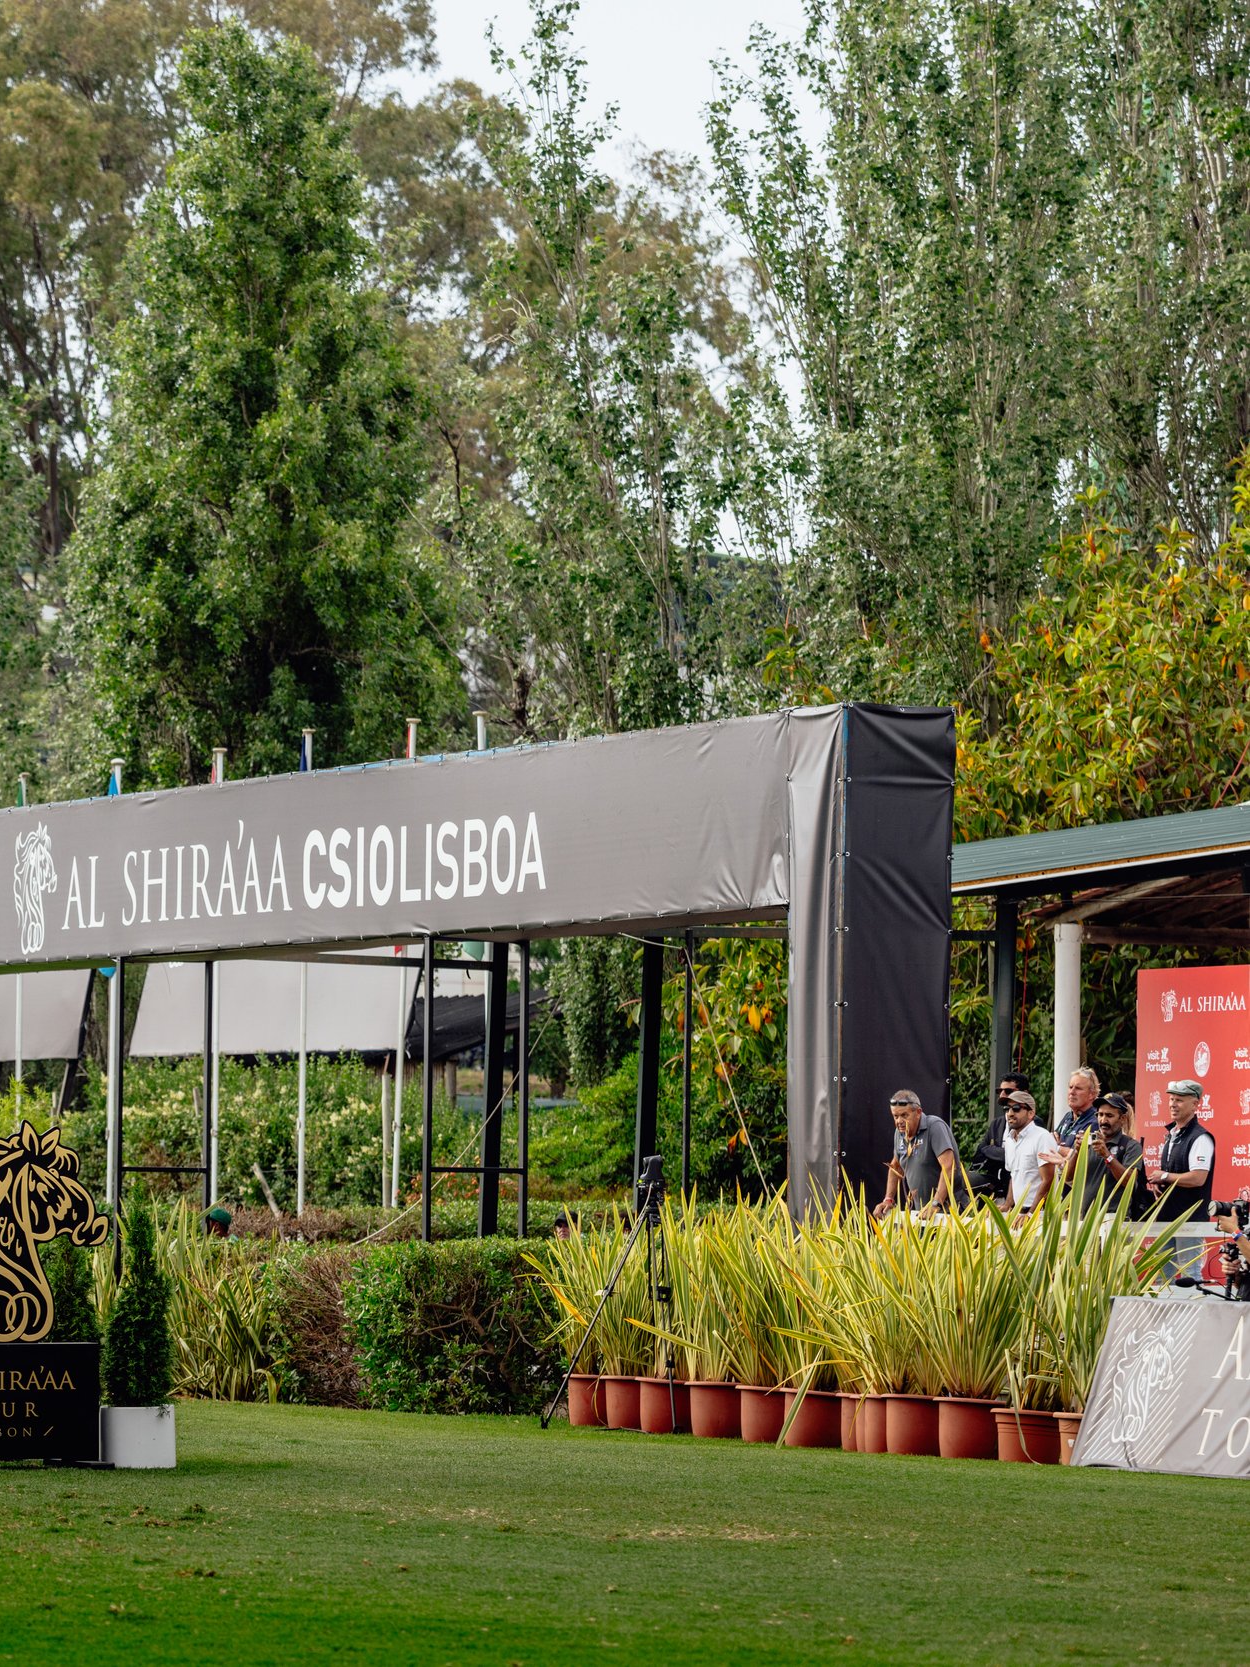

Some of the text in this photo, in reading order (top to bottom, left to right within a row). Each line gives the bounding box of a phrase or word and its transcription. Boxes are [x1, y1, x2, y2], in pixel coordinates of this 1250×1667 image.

[61, 811, 547, 930] AL SHIRA'AA CSIOLISBOA
[1179, 991, 1247, 1013] AL SHIRA'AA
[1147, 1050, 1160, 1060] visit
[1235, 1047, 1249, 1058] visit
[1145, 1062, 1172, 1074] Portugal
[1233, 1059, 1250, 1070] Portu
[1194, 1109, 1214, 1121] rtugal
[1233, 1145, 1247, 1155] visit
[1144, 1157, 1161, 1167] Portu
[1232, 1156, 1250, 1167] Portu
[1211, 1315, 1250, 1380] A
[1196, 1407, 1250, 1459] TO
